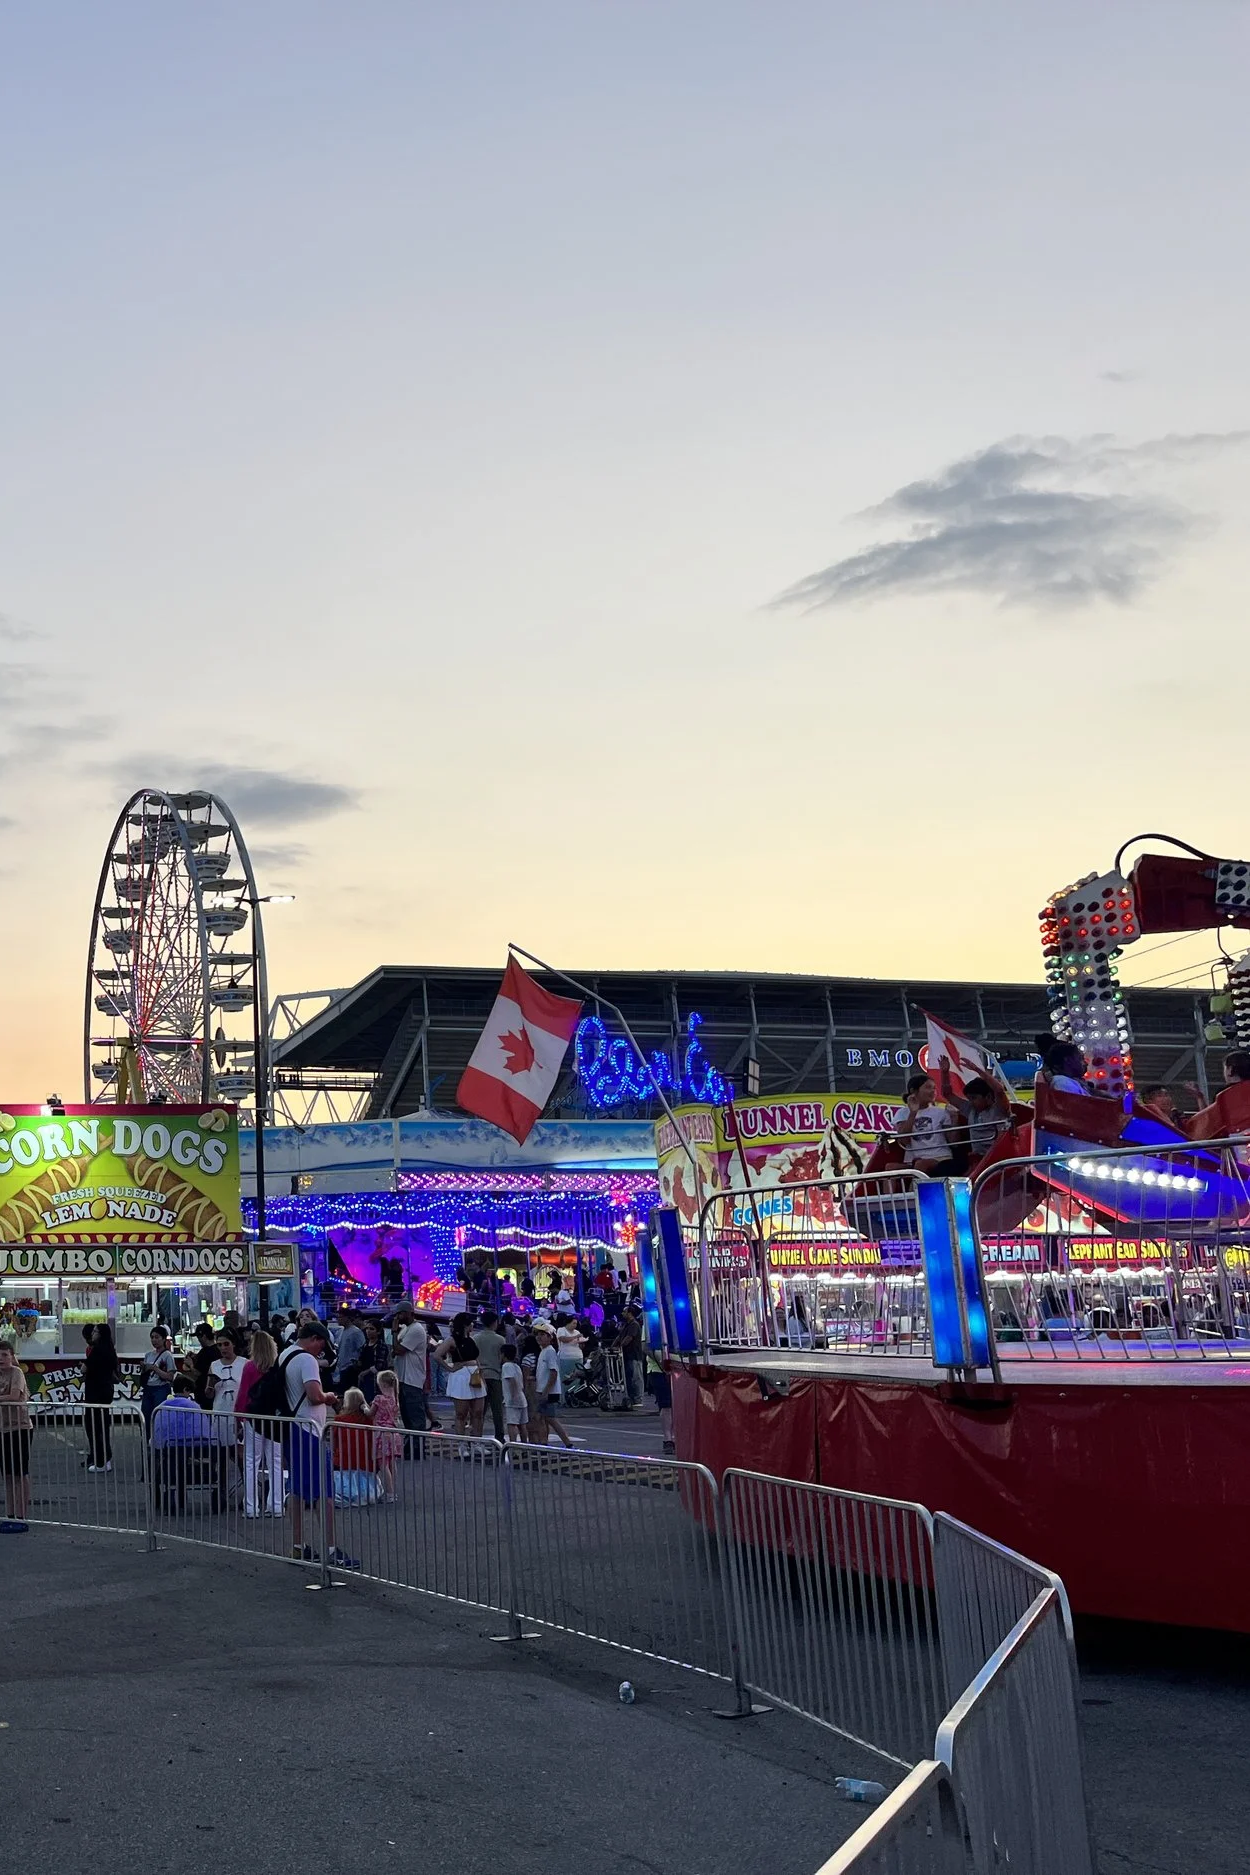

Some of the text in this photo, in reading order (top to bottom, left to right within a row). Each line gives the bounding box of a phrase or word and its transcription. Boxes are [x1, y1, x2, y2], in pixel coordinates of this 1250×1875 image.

[846, 1048, 914, 1068] BMO
[112, 1119, 228, 1175] DOGS
[52, 1186, 167, 1205] FRESH SQUEEZED
[733, 1196, 793, 1227] CONES
[121, 1248, 244, 1273] CORNDOGS
[42, 1366, 84, 1385] FRES
